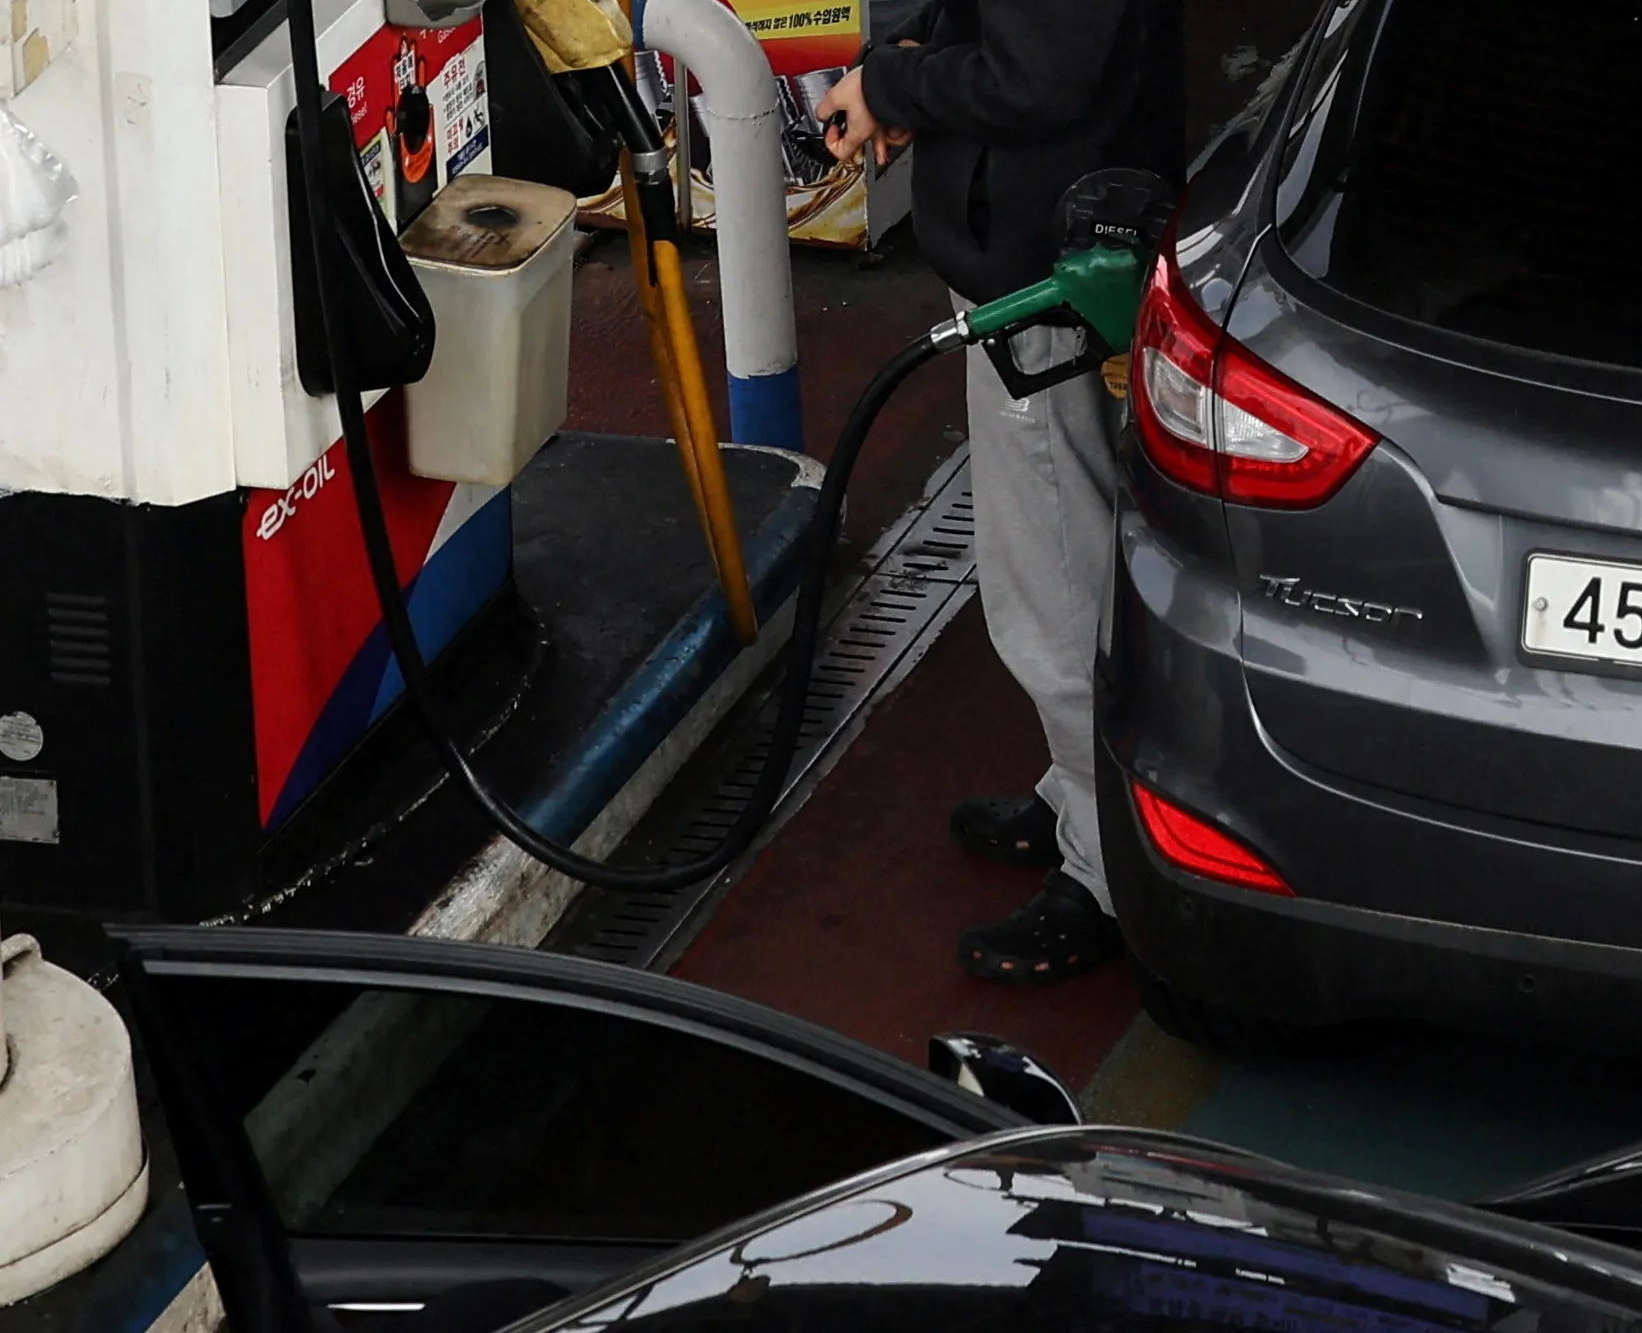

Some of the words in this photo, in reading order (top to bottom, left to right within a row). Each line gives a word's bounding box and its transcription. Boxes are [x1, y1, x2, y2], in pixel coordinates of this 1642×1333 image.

[788, 12, 812, 30] 100%
[813, 5, 852, 26] 수입원액
[347, 76, 365, 109] 경유
[256, 454, 335, 540] ex-OIL
